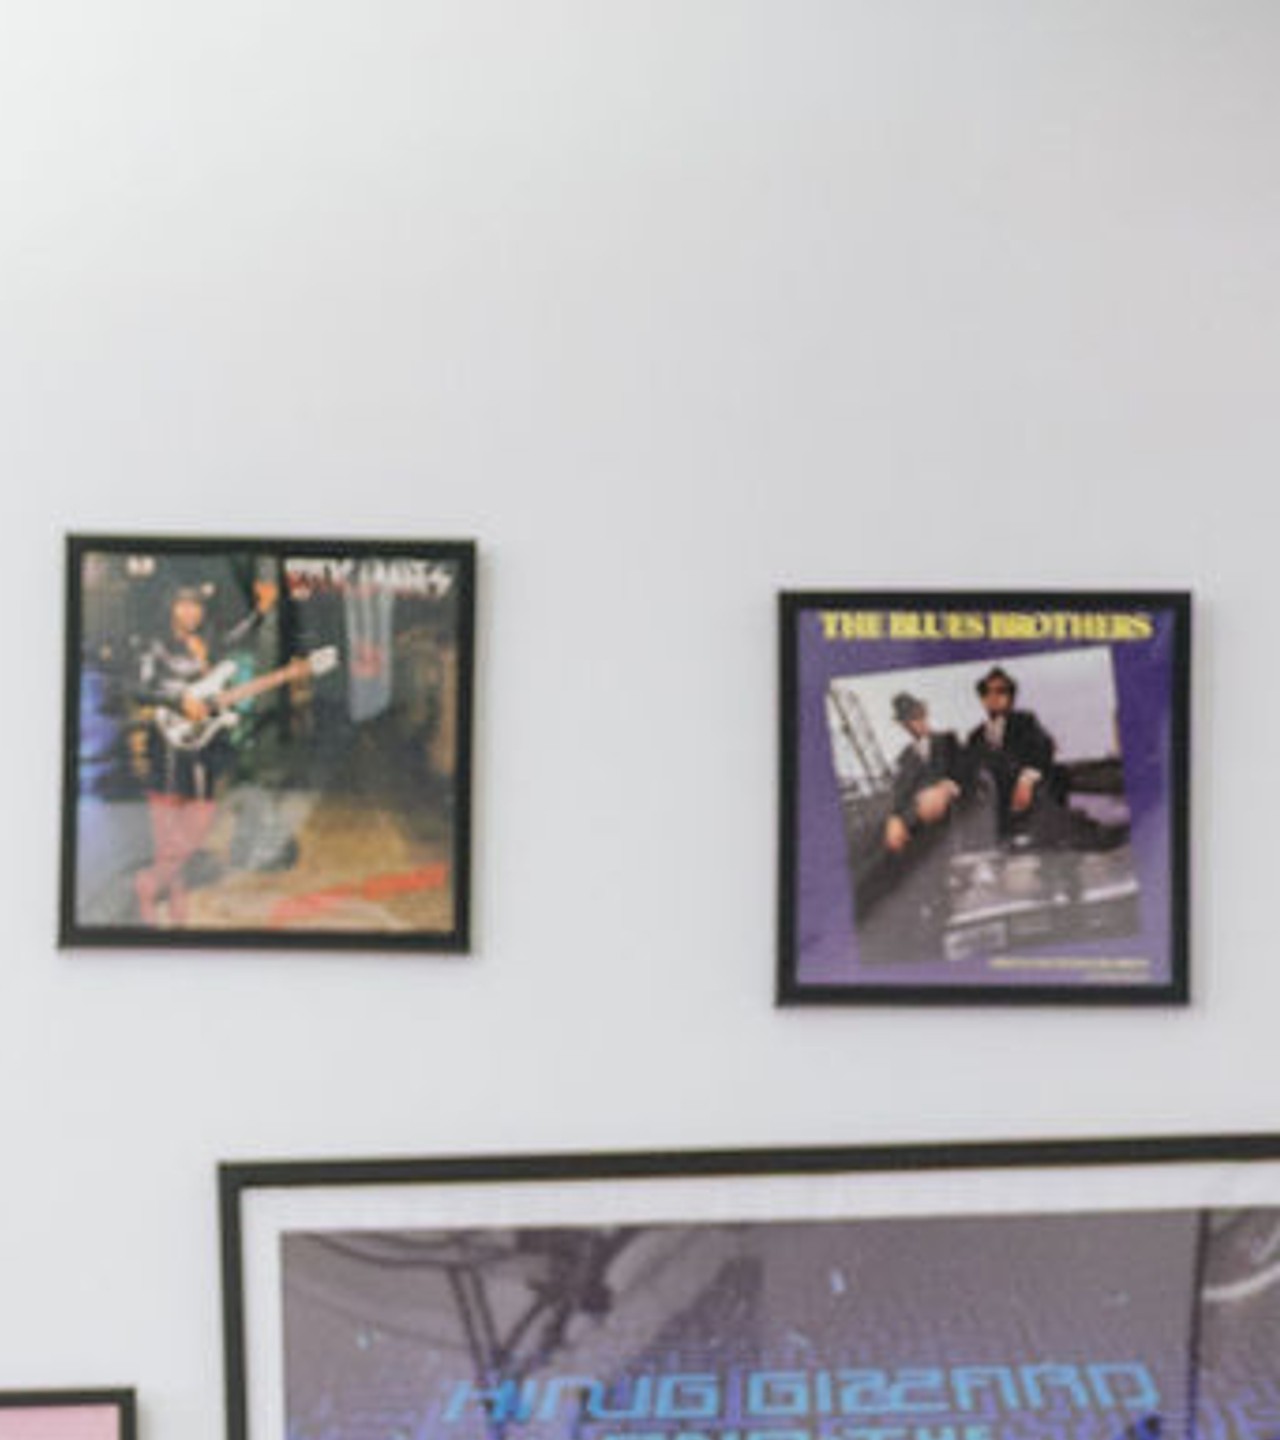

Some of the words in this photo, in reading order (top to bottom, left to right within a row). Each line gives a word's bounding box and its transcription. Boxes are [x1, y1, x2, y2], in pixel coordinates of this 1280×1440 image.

[821, 611, 883, 640] THE
[888, 611, 987, 640] BLUES
[989, 610, 1154, 640] BROTHERS
